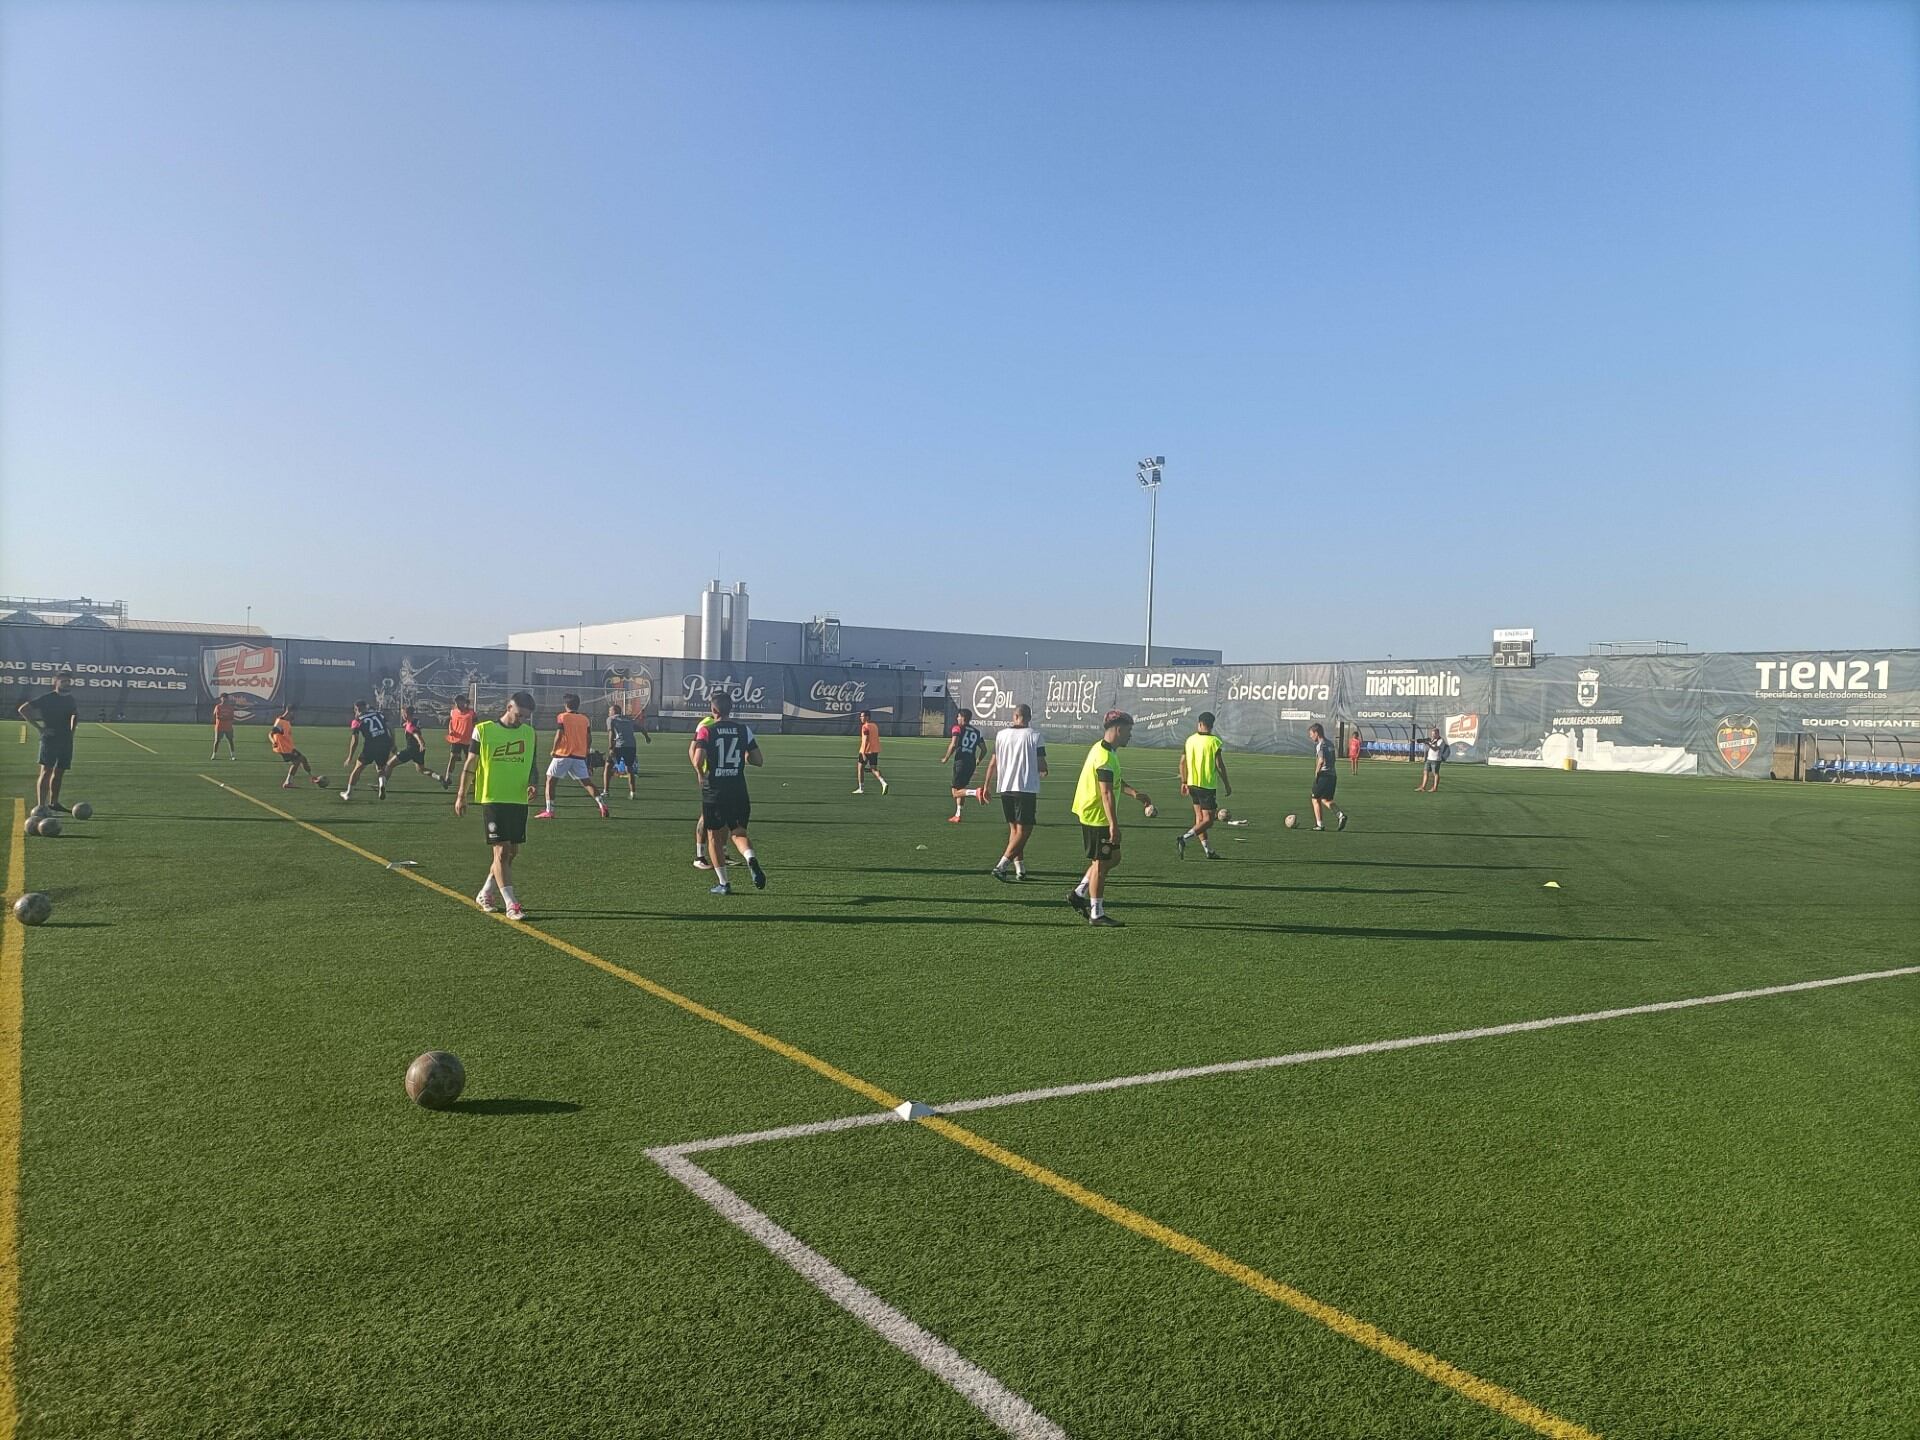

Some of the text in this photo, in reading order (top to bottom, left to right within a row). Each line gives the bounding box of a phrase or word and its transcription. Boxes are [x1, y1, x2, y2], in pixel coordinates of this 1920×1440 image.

[32, 661, 72, 671] ESTÁ
[0, 676, 14, 685] S
[89, 678, 123, 688] SON
[127, 681, 187, 690] REALES
[1136, 673, 1210, 688] URBINA
[1365, 671, 1461, 697] marsamatic
[1755, 690, 1802, 699] Especialistas
[1803, 691, 1813, 699] en
[824, 701, 853, 712] zero
[363, 715, 385, 732] 21
[1802, 718, 1920, 728] EQUIPO VISITANTE
[961, 730, 978, 748] 69
[715, 737, 741, 768] 14
